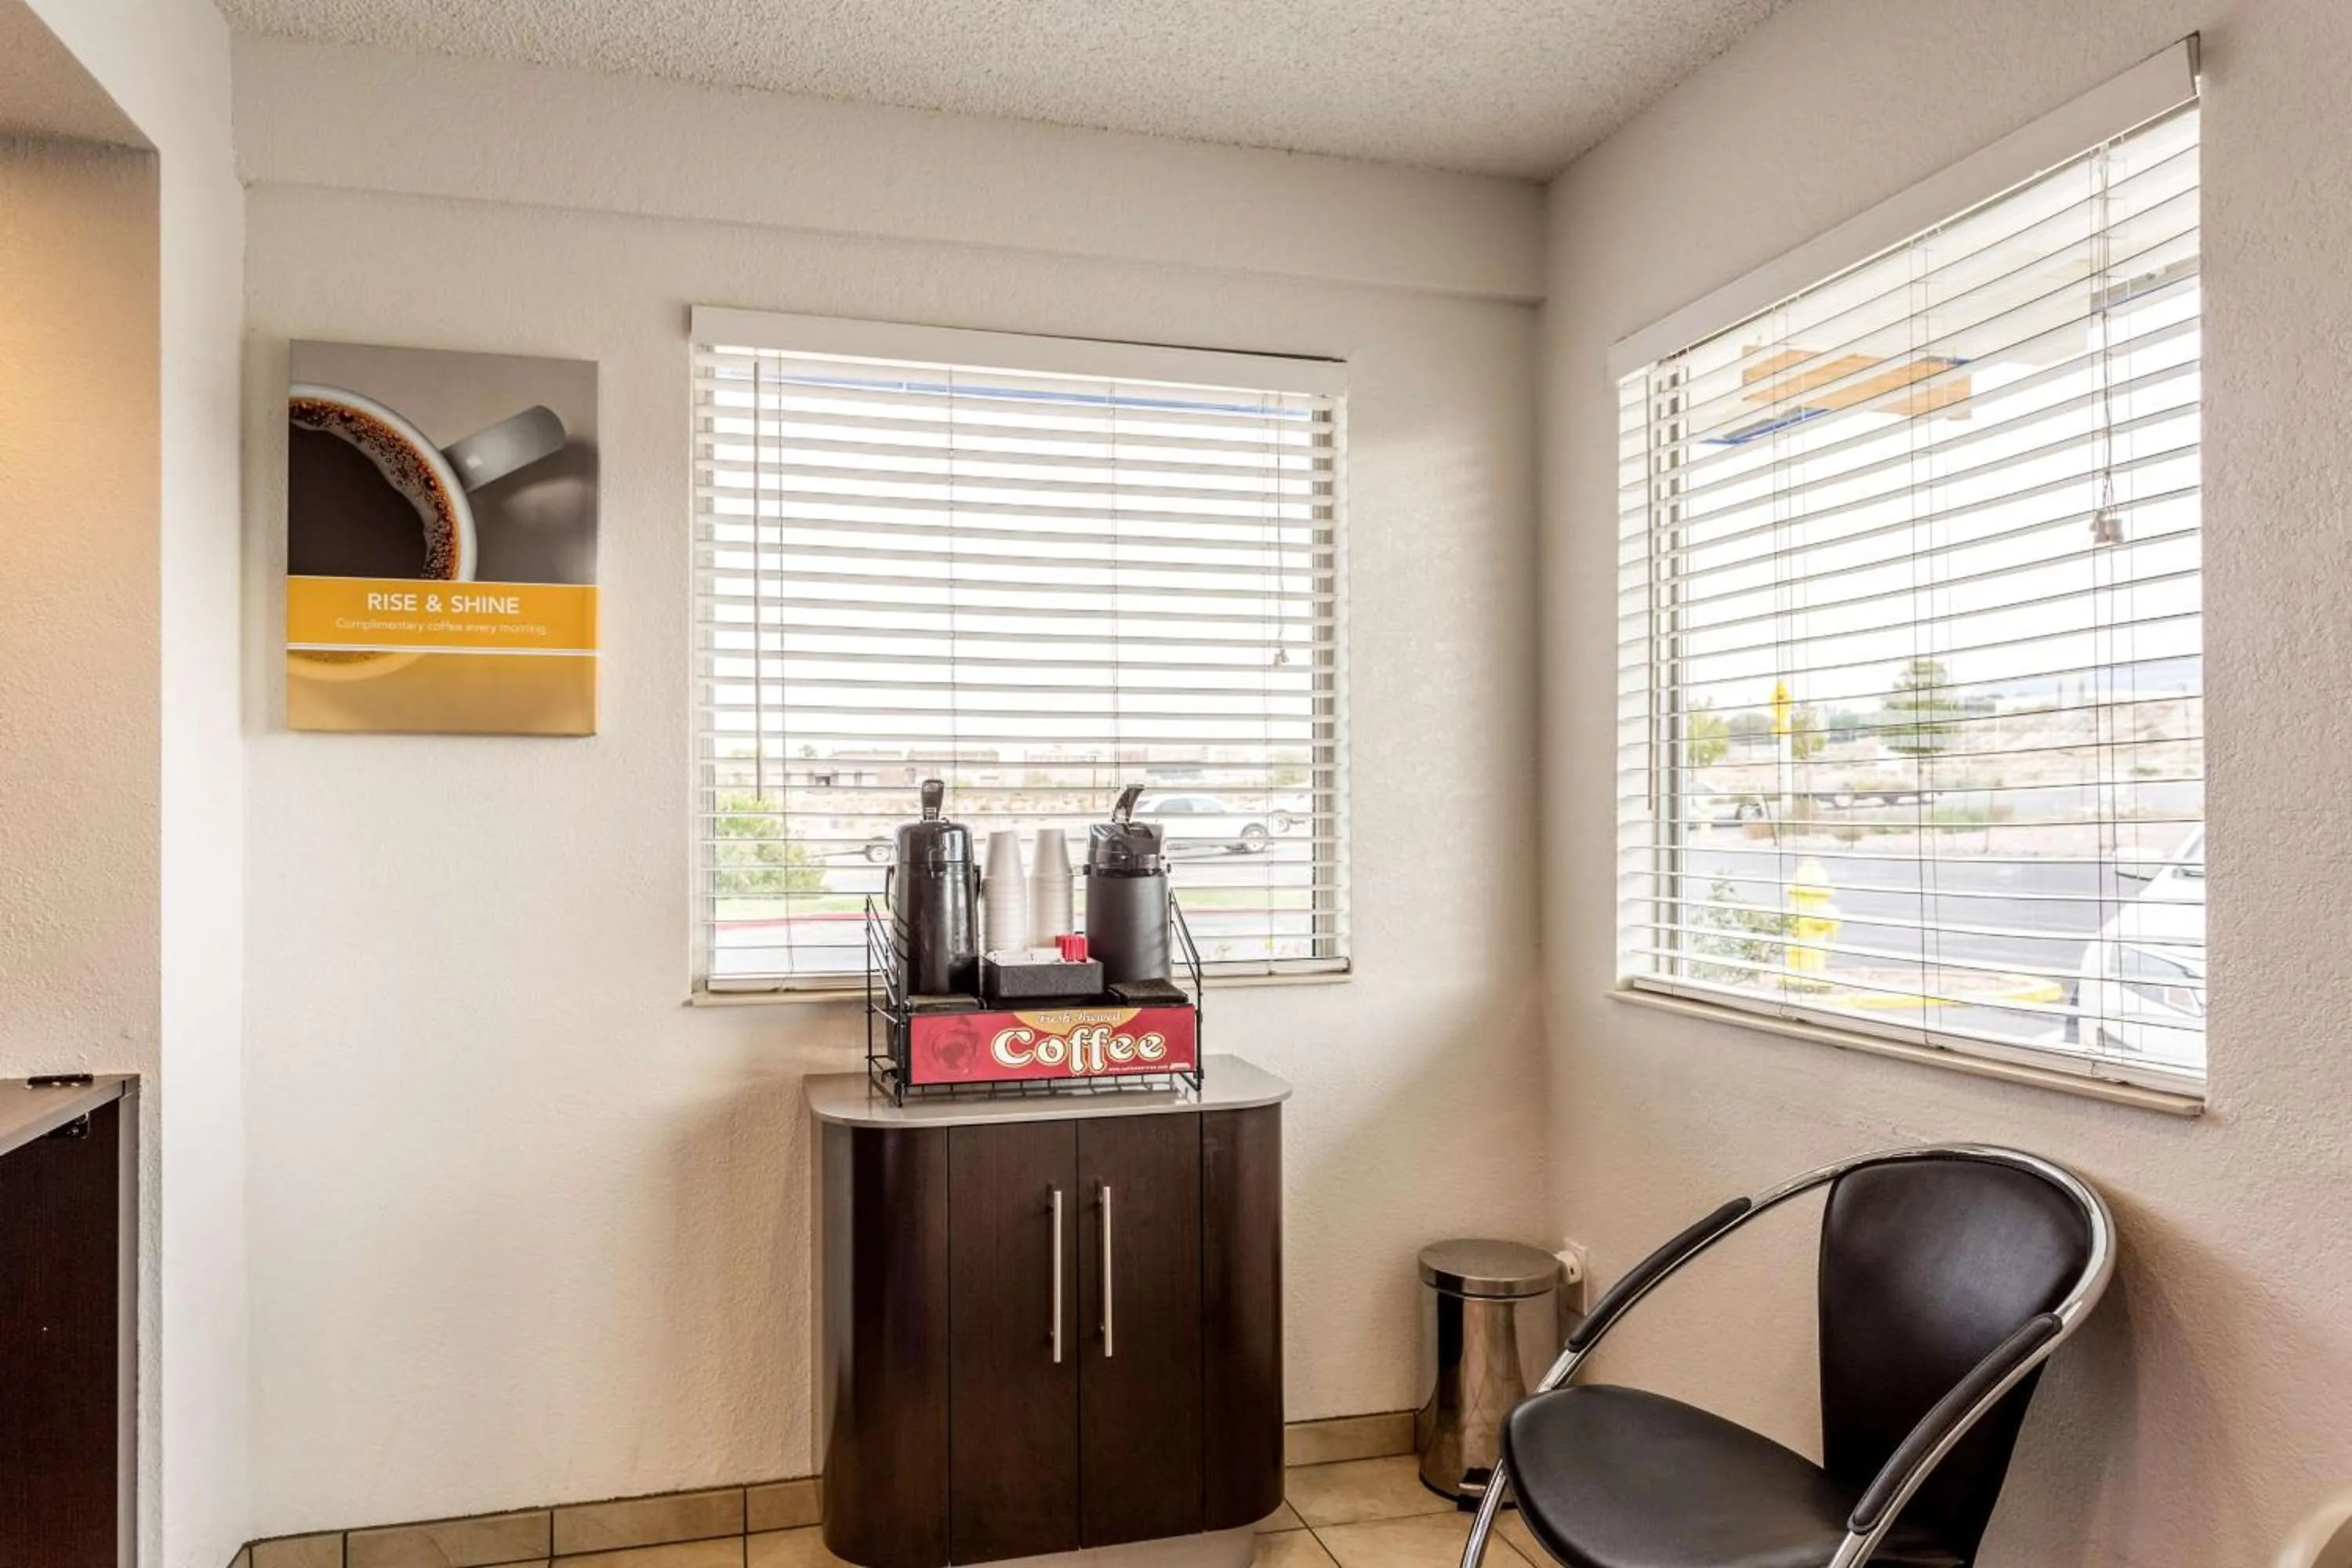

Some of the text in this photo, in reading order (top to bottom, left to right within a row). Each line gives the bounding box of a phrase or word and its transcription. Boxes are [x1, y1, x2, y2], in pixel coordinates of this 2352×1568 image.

[367, 592, 521, 615] RISE & SHINE
[336, 617, 423, 632] Complimentary
[427, 619, 463, 631] coffee
[466, 624, 495, 634] every
[993, 1024, 1166, 1073] Coffee
